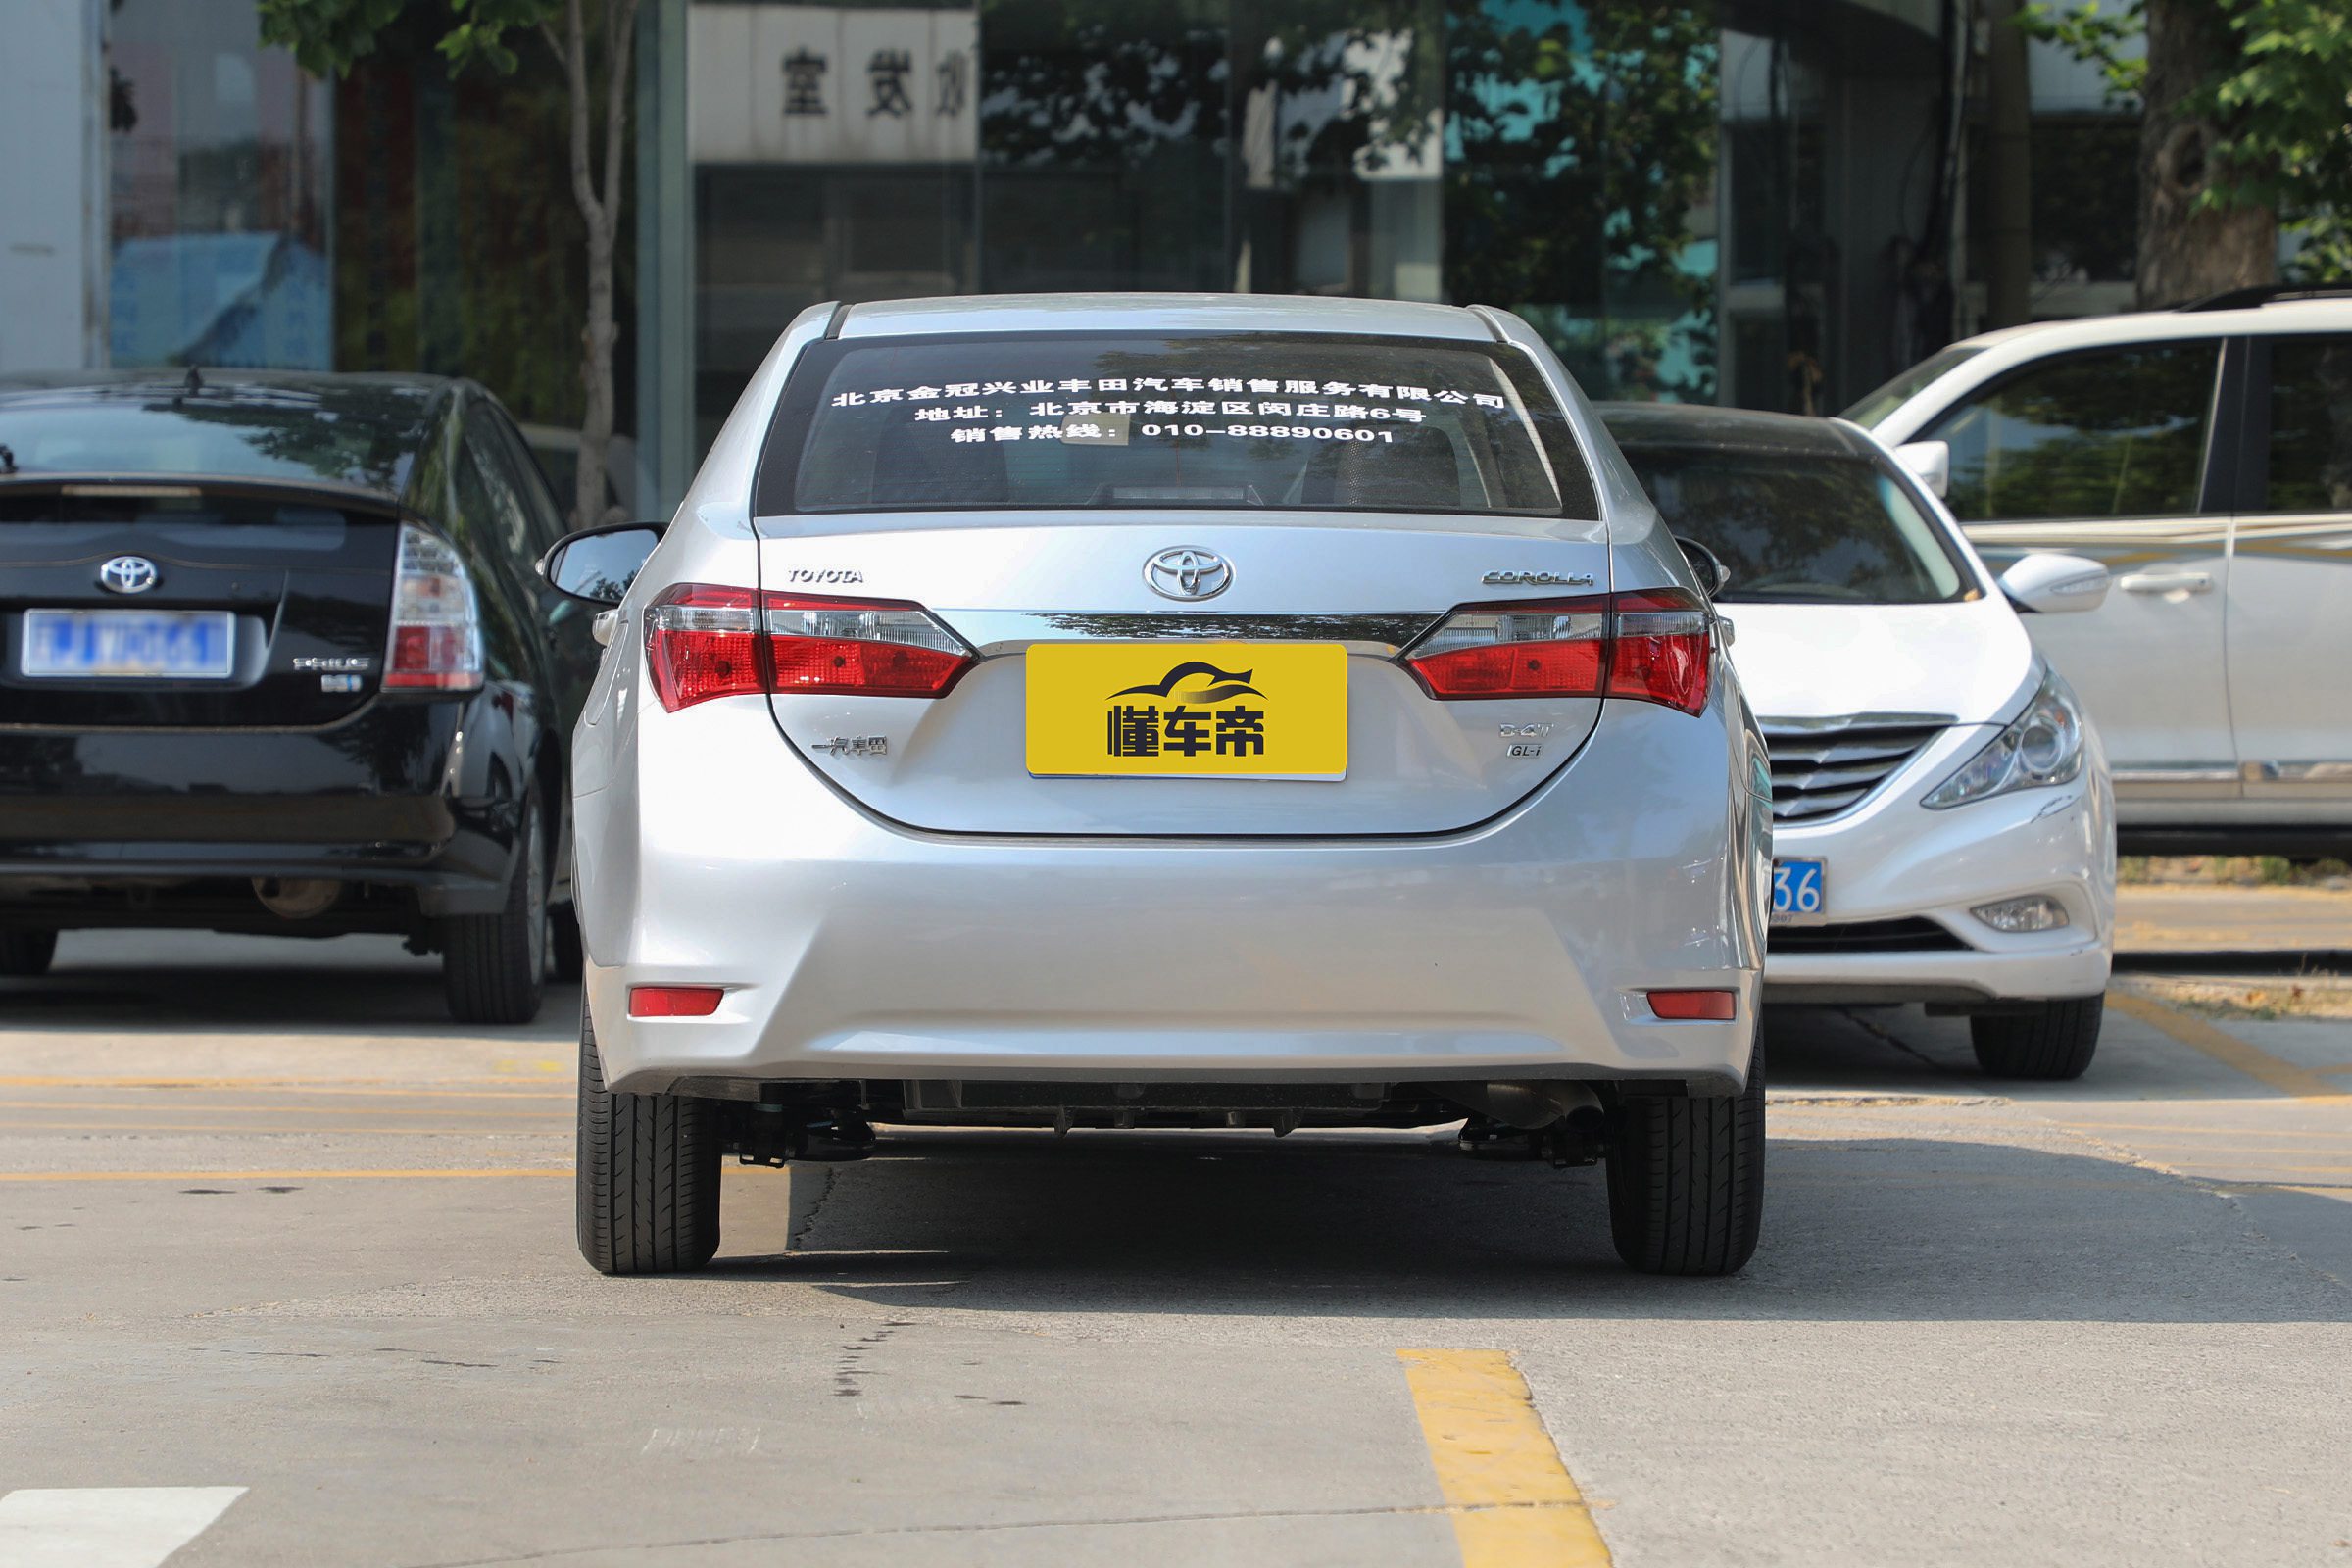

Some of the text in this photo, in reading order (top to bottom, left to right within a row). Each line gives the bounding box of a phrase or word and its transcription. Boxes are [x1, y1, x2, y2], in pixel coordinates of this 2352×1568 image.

[831, 378, 1505, 409] 北京金冠兴业丰田汽车销售服务有限公司
[788, 569, 864, 584] TOYOTA
[1481, 570, 1593, 586] COROLLA
